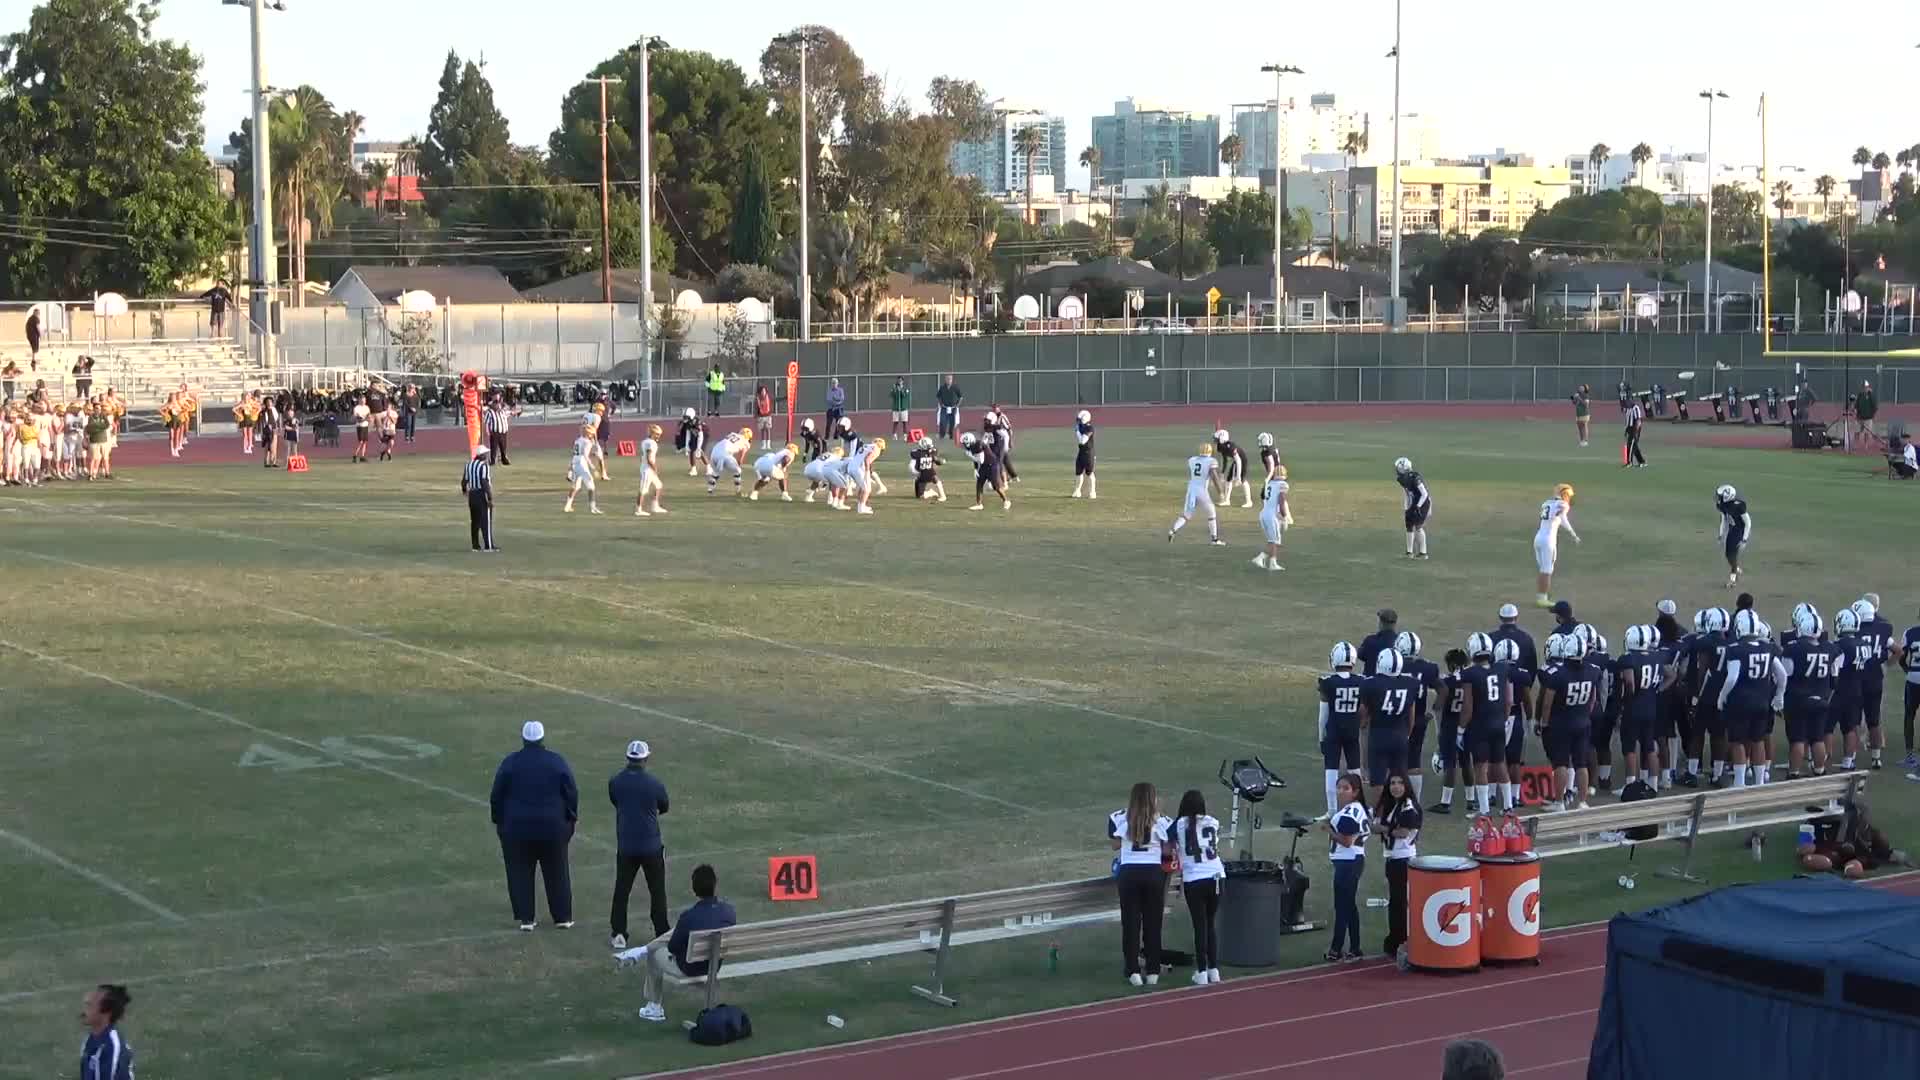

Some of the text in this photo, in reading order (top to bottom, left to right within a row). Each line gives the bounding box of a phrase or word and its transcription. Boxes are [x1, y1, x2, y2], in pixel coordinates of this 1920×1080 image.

[291, 458, 305, 469] 20
[1194, 463, 1202, 477] 2
[1640, 663, 1660, 689] 84
[1748, 652, 1770, 679] 57
[1804, 652, 1829, 678] 75
[1334, 687, 1360, 713] 25
[1487, 675, 1499, 701] 6
[1566, 680, 1592, 706] 58
[1381, 688, 1408, 715] 47
[1522, 772, 1552, 801] 30
[774, 861, 812, 895] 40
[1422, 886, 1472, 947] G
[1508, 875, 1540, 937] G
